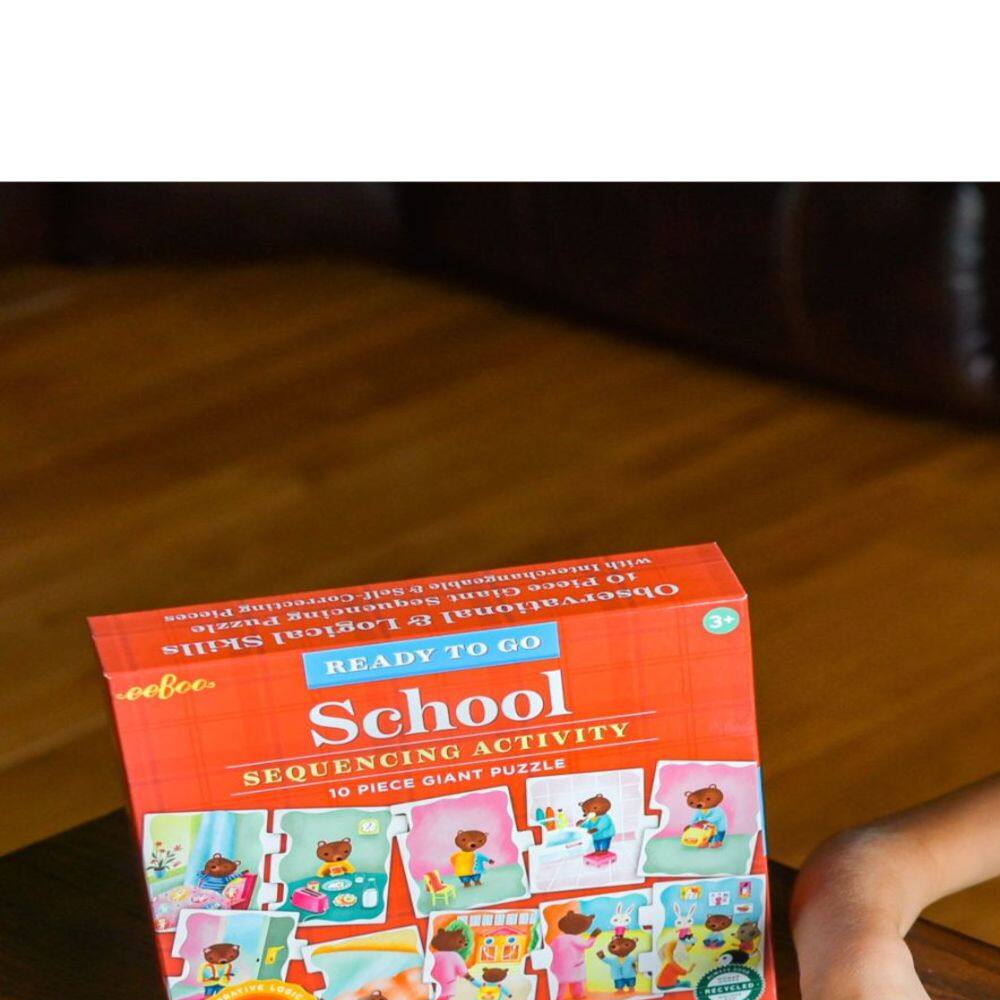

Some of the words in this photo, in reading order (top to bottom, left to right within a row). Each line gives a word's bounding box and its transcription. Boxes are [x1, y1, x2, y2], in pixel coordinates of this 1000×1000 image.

[604, 557, 652, 571] with
[429, 563, 601, 591] Interchangeable
[527, 579, 600, 593] Piece
[606, 573, 637, 584] 10
[239, 587, 405, 613] Self-Correcting
[442, 583, 680, 624] Observational
[449, 586, 522, 603] Giant
[163, 607, 233, 622] Pieces
[287, 596, 441, 622] Sequencing
[407, 614, 433, 627] &
[710, 613, 735, 629] 3+
[190, 616, 280, 634] Puzzle
[271, 617, 402, 645] Logical
[161, 635, 265, 657] Skills
[324, 650, 434, 676] READY
[445, 642, 488, 660] TO
[497, 635, 542, 653] GO
[308, 669, 573, 749] School
[242, 743, 461, 787] SEQUENCING
[472, 722, 630, 756] ACTIVITY
[328, 786, 351, 799] 10
[357, 778, 415, 796] PIECE
[421, 769, 483, 787] GIANT
[490, 758, 566, 779] PUZZLE
